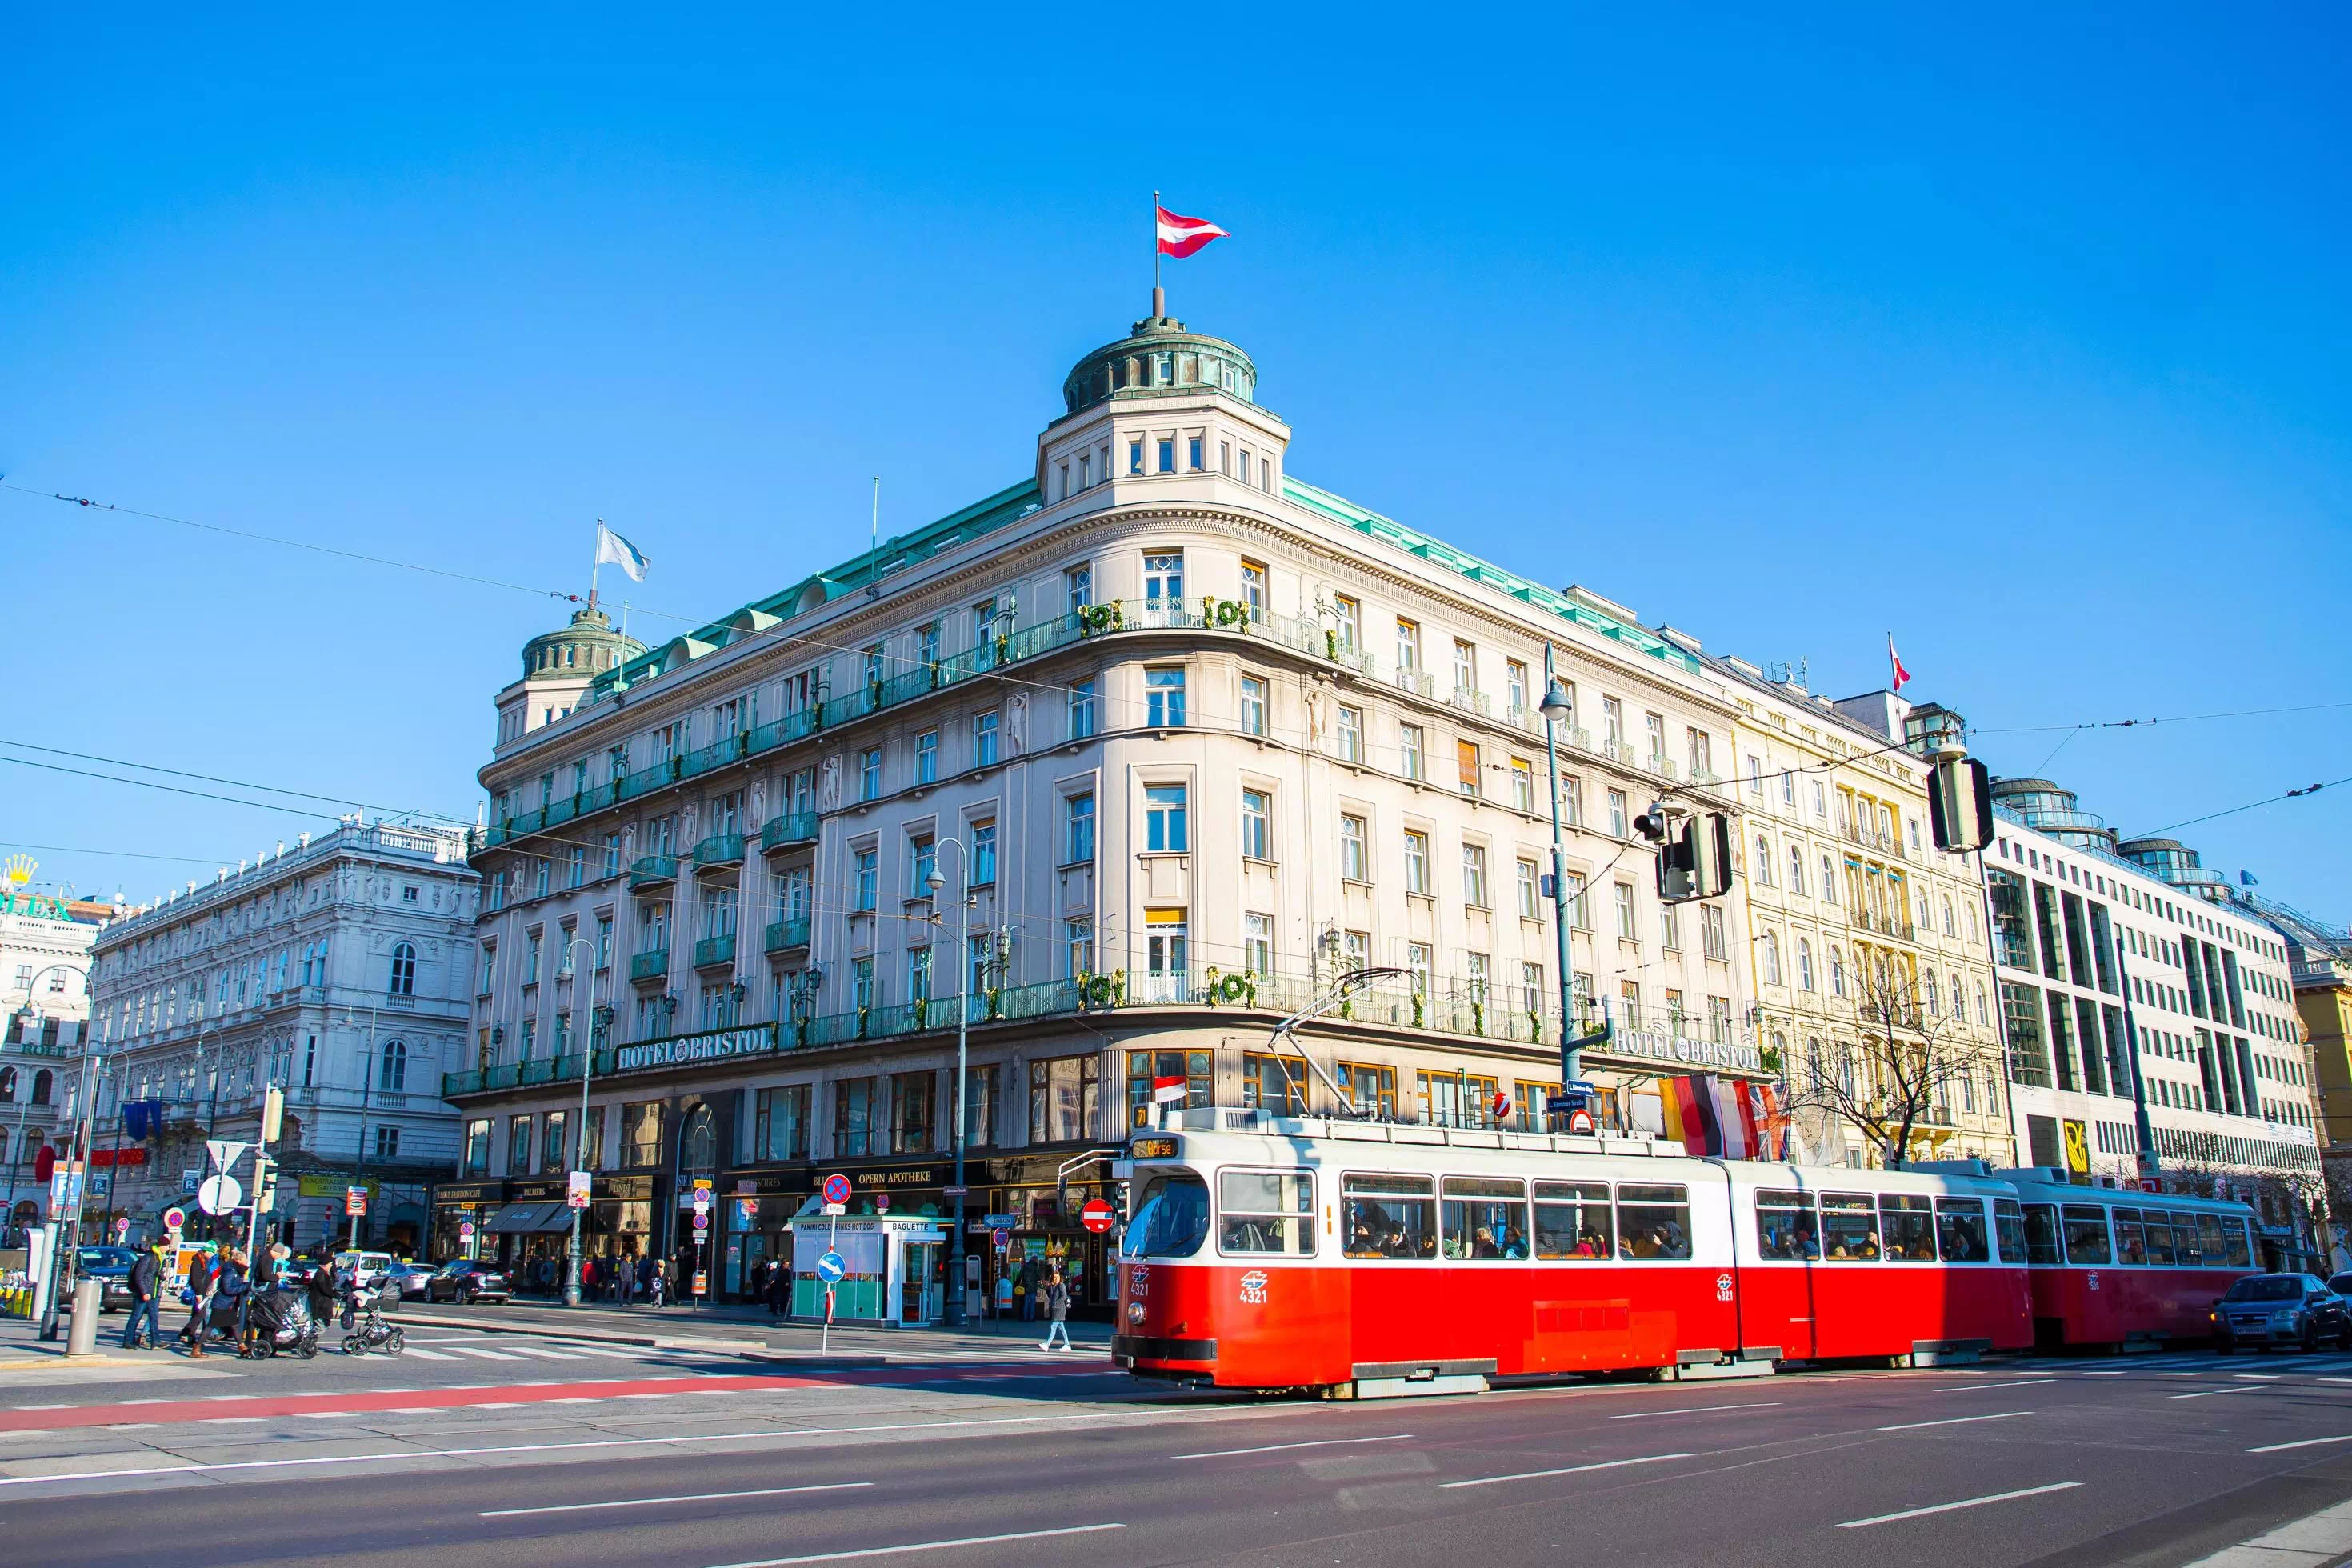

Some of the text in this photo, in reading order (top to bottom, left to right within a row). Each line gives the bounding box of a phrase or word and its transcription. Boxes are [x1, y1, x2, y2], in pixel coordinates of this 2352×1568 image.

[0, 893, 73, 922] LEX
[618, 1027, 773, 1070] HOTEL BRISTOL
[1613, 1028, 1759, 1070] HOTEL BRISTOL
[1138, 1109, 1146, 1127] 71
[858, 1170, 931, 1184] OPERN APOTHEKE
[523, 1187, 546, 1196] PALMERS
[800, 1222, 874, 1231] PANINI COLD RINKS HOT DOG
[892, 1222, 929, 1231] BAGUETTE
[1130, 1283, 1149, 1296] 4321
[1716, 1290, 1734, 1302] 4321
[1239, 1290, 1267, 1304] 4321
